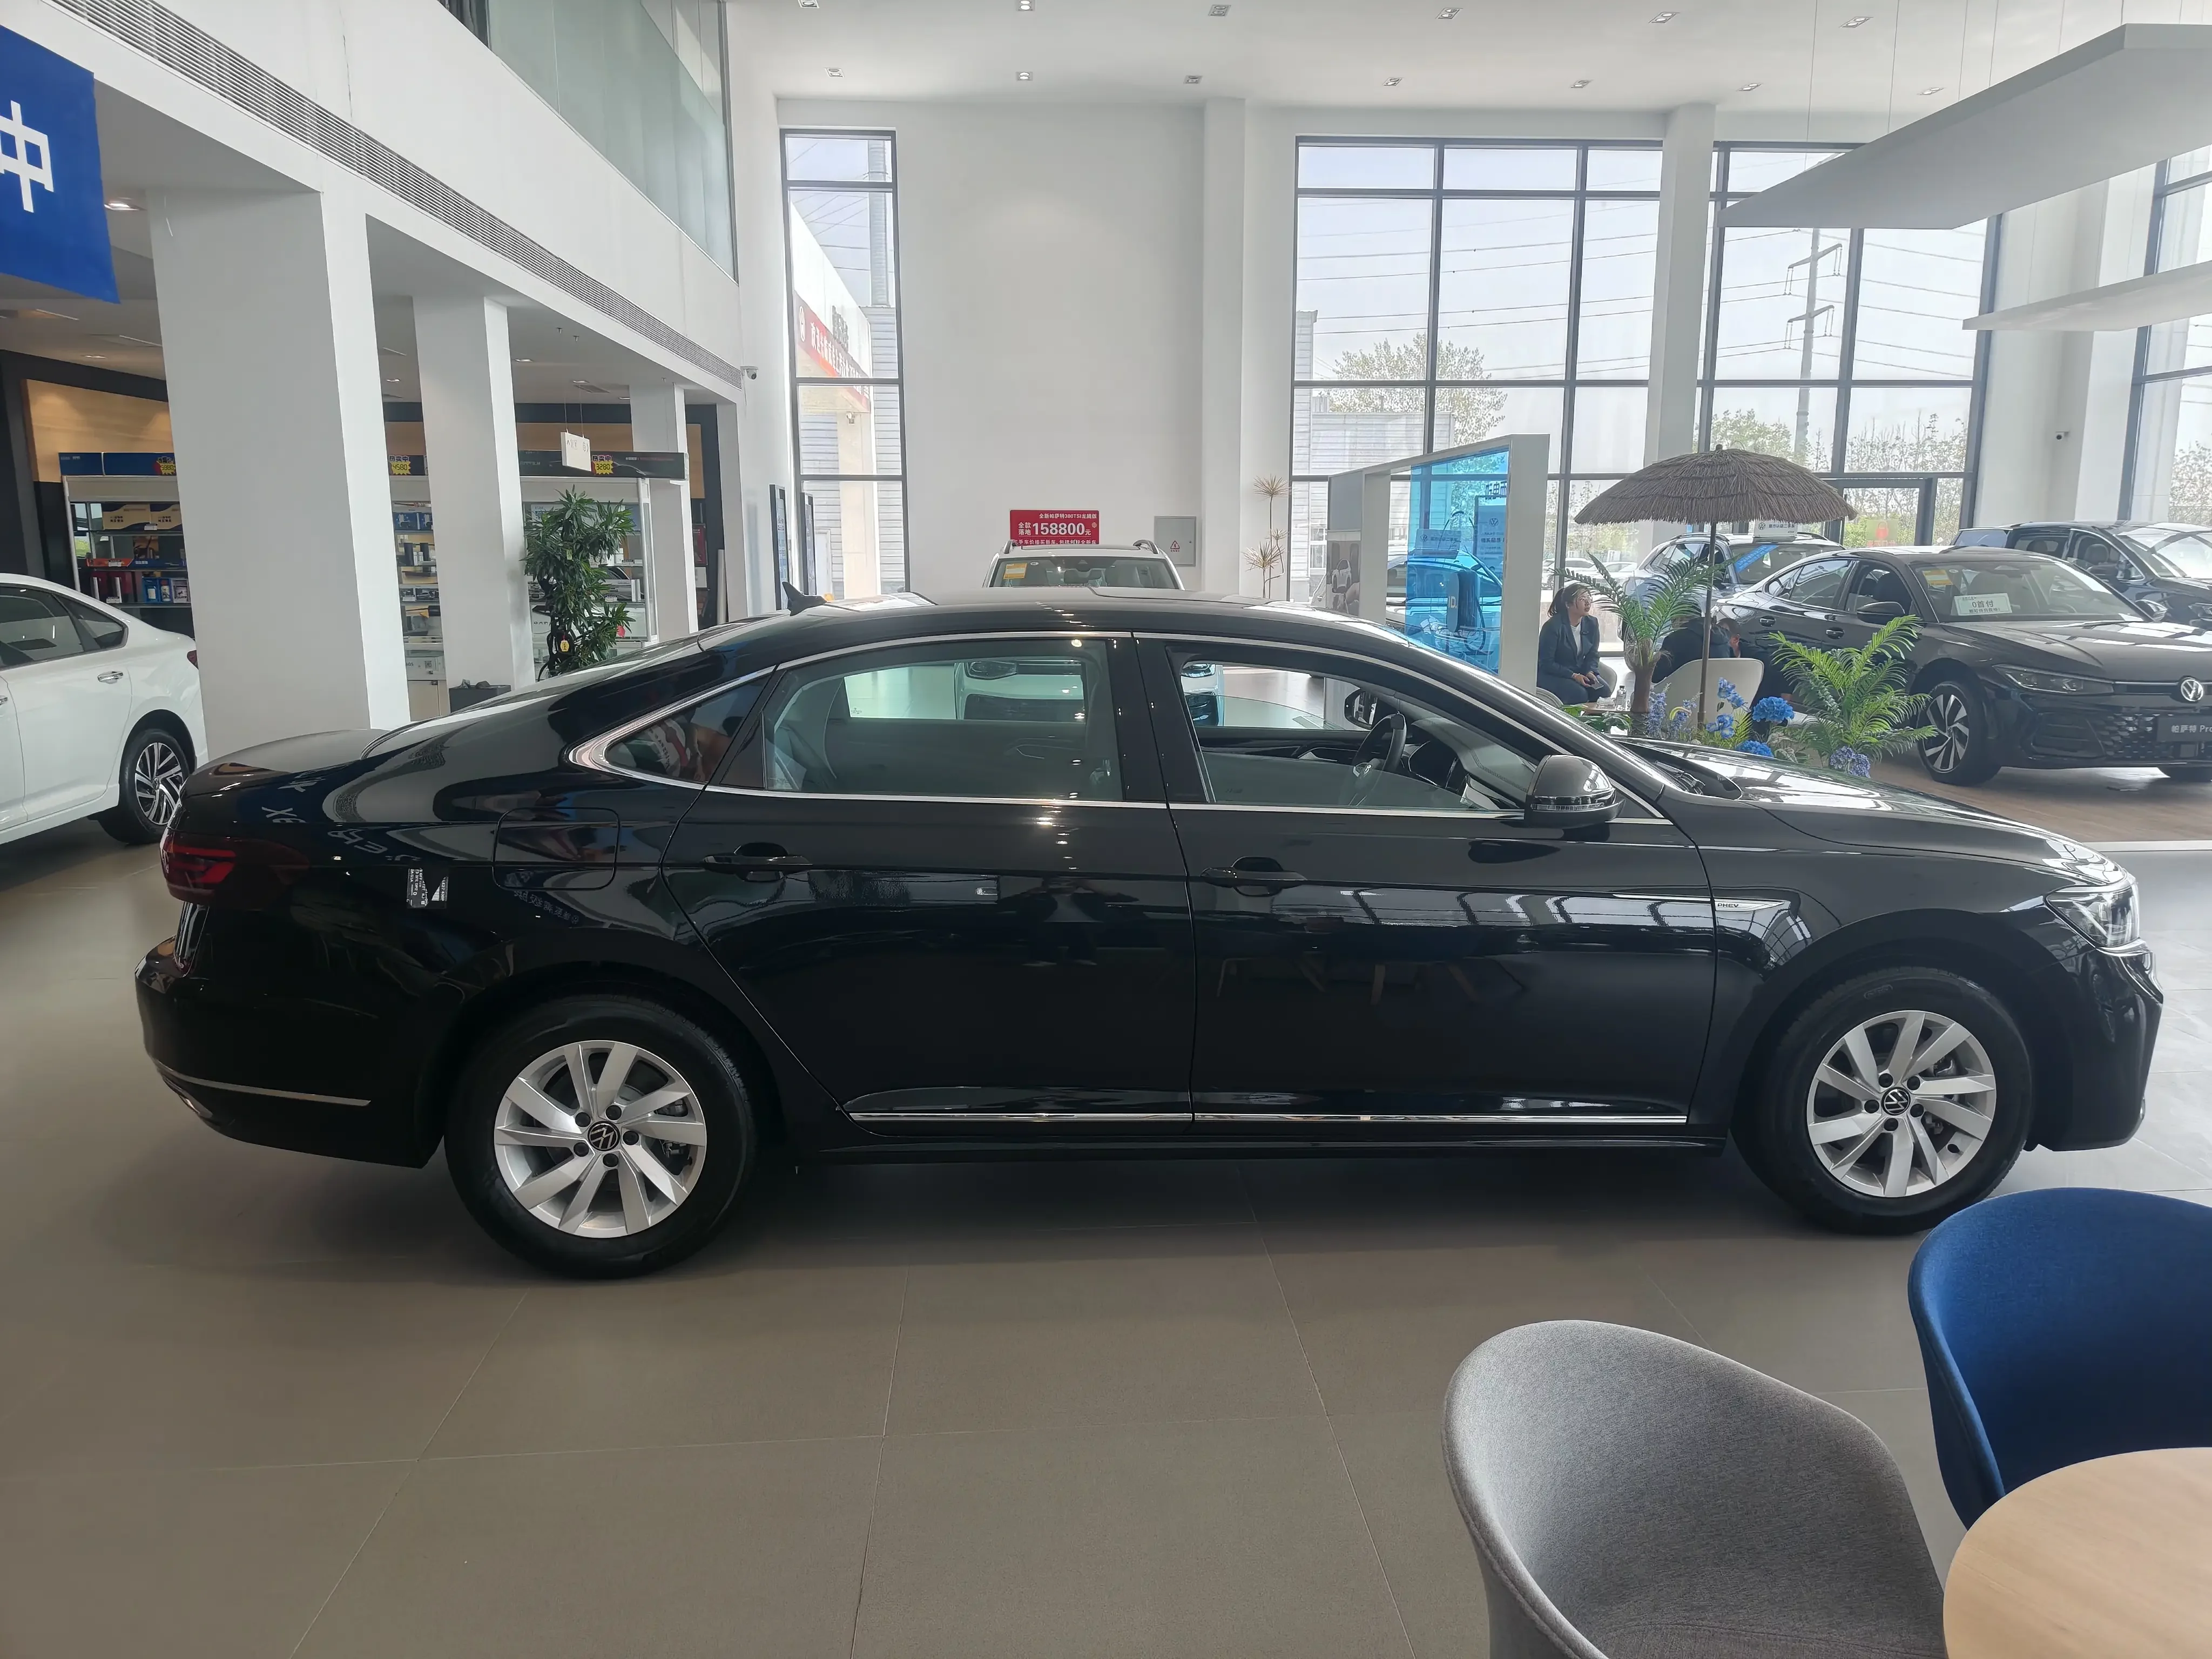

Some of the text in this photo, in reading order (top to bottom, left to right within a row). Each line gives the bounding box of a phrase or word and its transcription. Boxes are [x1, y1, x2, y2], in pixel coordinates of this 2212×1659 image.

[1972, 600, 1994, 608] 0首付
[2171, 725, 2197, 733] 帕萨特
